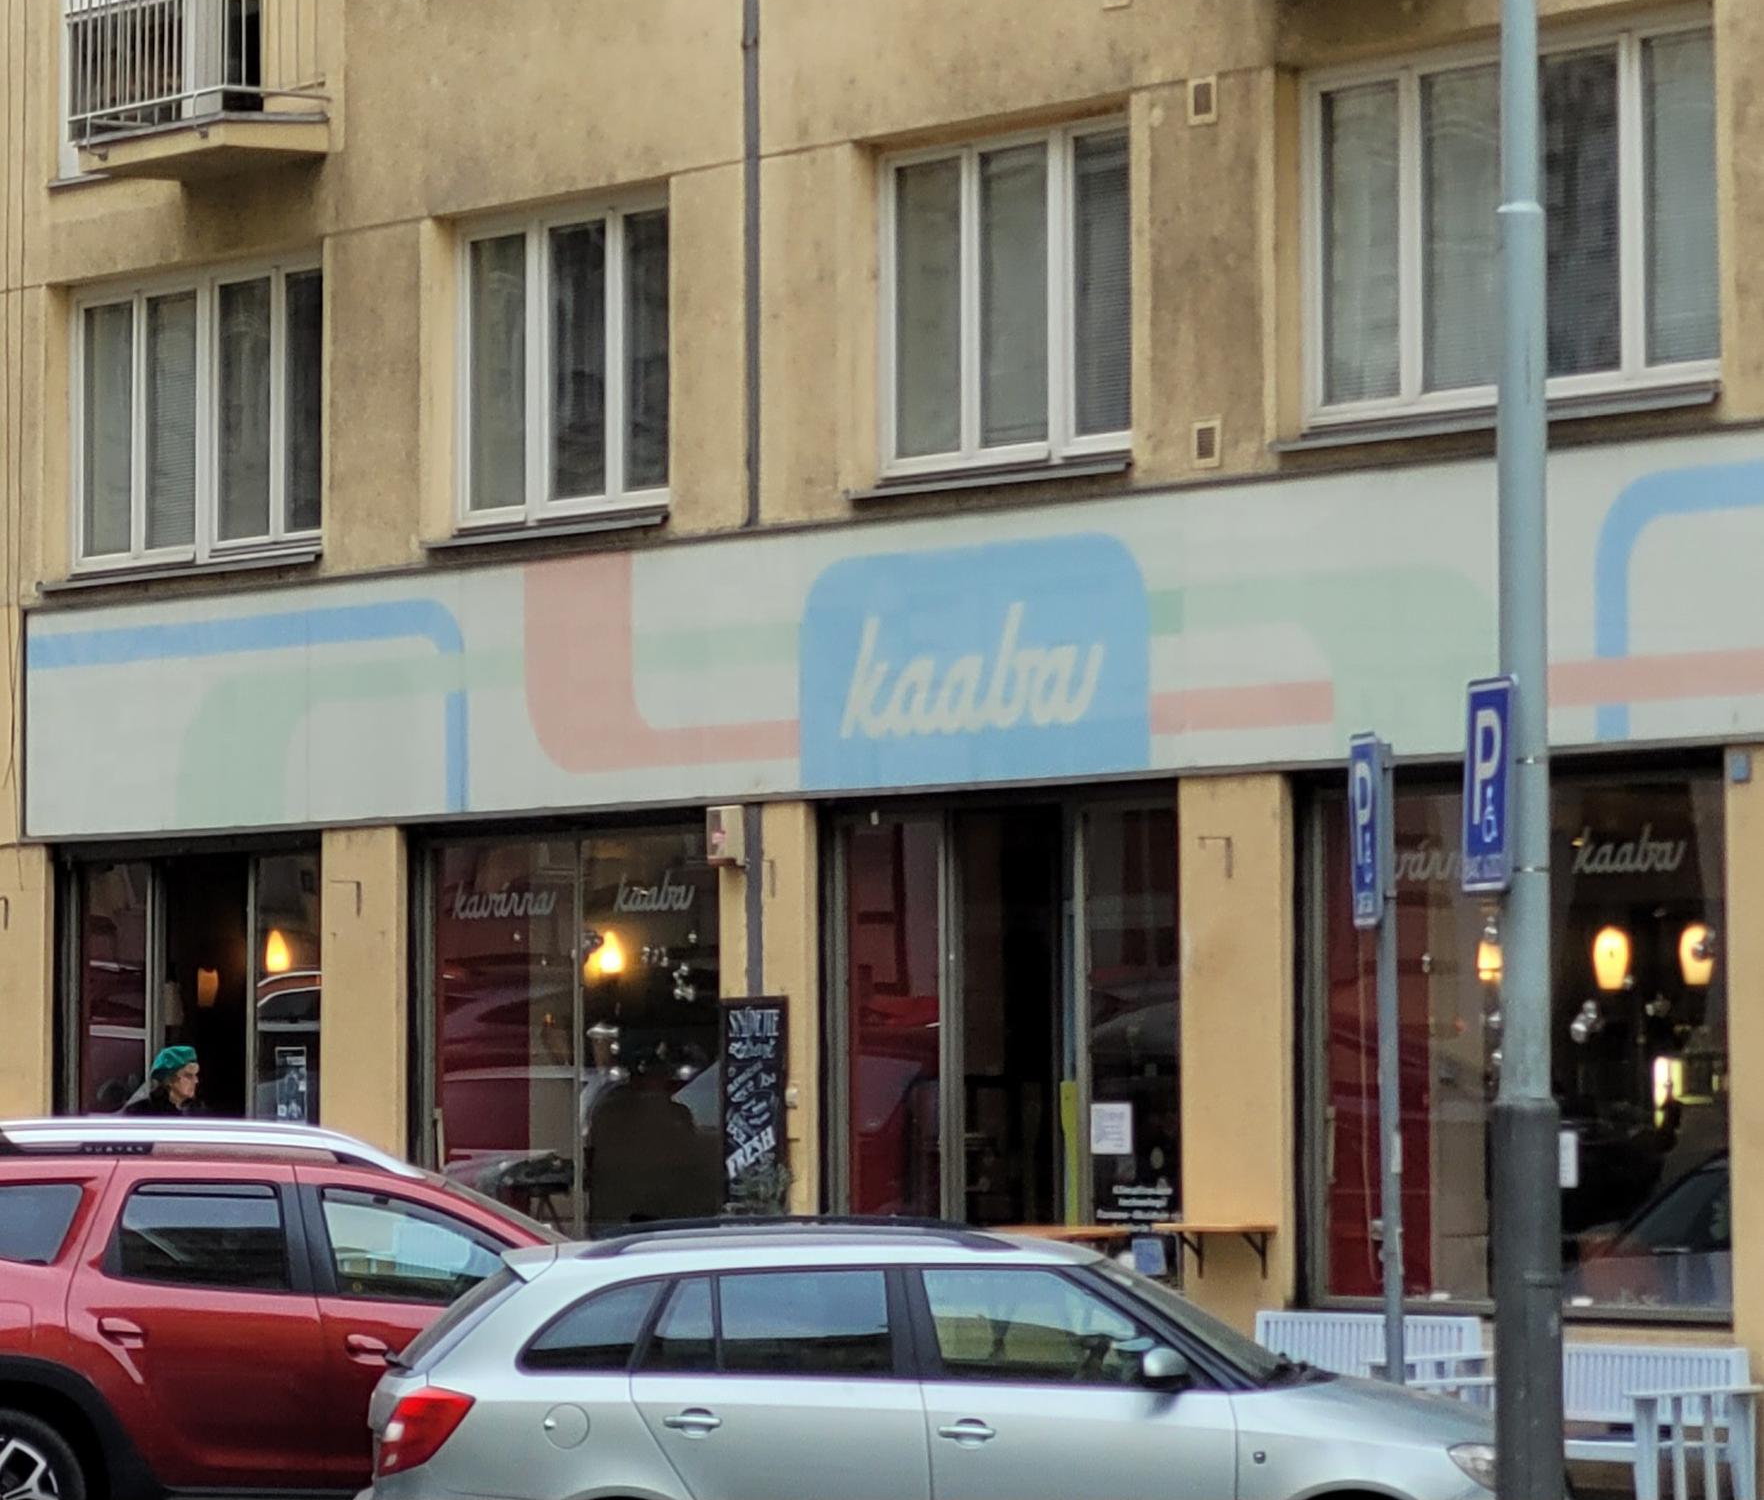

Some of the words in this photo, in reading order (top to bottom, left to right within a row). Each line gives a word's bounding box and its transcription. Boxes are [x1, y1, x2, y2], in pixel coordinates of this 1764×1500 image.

[839, 601, 1104, 740] kaaba
[1354, 761, 1373, 865] P
[1473, 708, 1502, 825] P
[452, 880, 557, 920] kavárna
[614, 870, 696, 913] kaaba
[1571, 823, 1687, 874] kaaba
